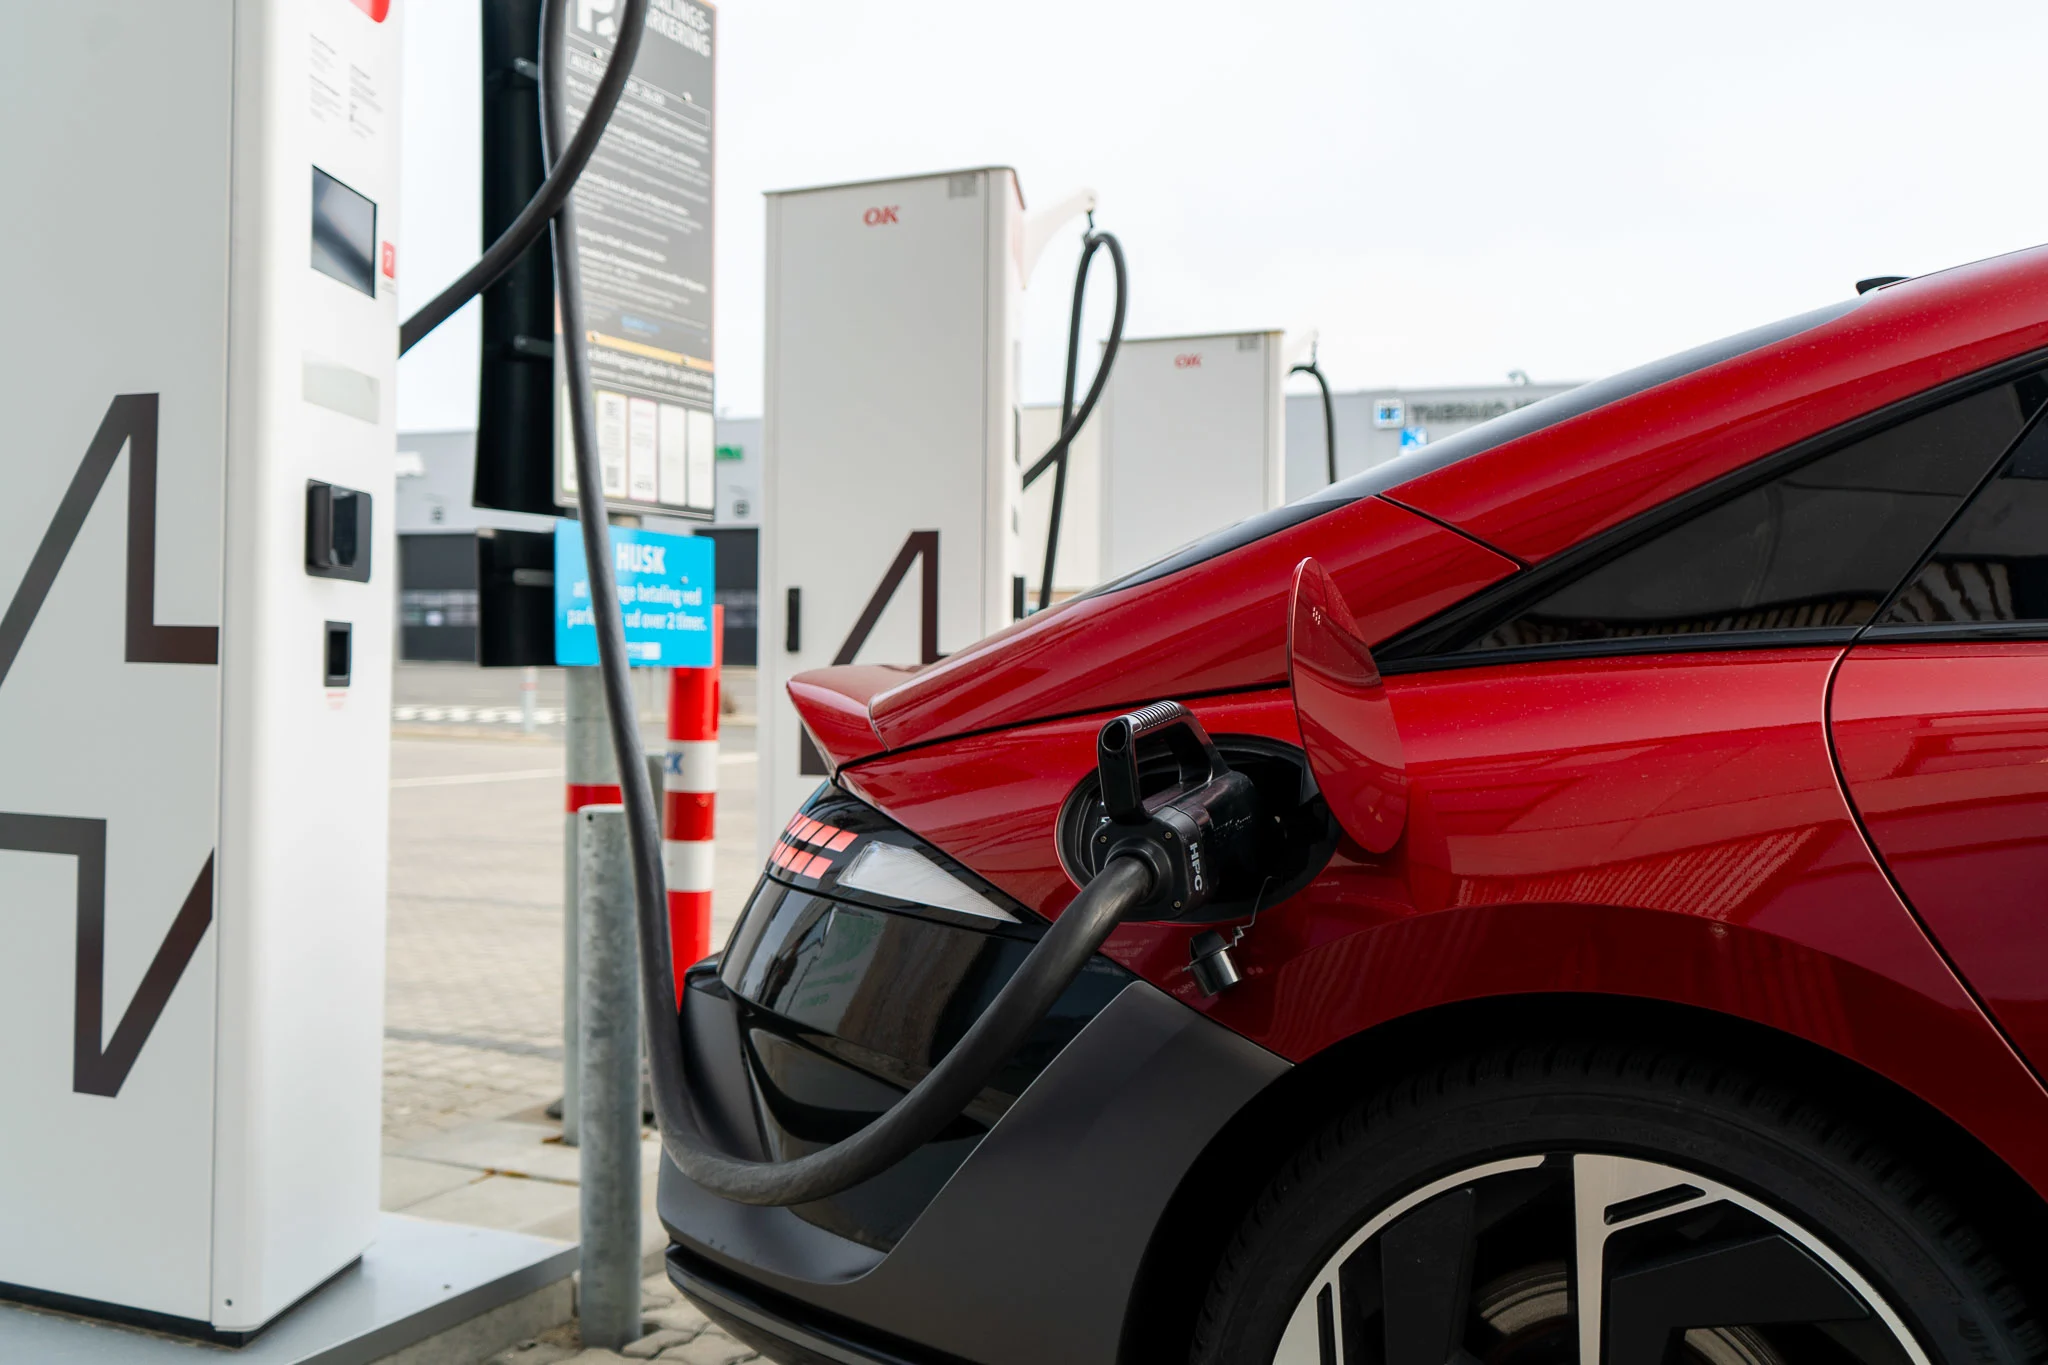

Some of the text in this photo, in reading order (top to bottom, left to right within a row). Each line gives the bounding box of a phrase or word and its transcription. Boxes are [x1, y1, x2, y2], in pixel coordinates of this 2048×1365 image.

[863, 204, 902, 227] OK
[1174, 352, 1203, 370] OK
[616, 543, 666, 574] HUSK
[637, 582, 681, 608] betaling
[681, 586, 703, 607] ved
[625, 608, 641, 629] ud
[641, 613, 667, 630] over
[667, 611, 676, 631] 2
[1189, 842, 1203, 891] HPC
